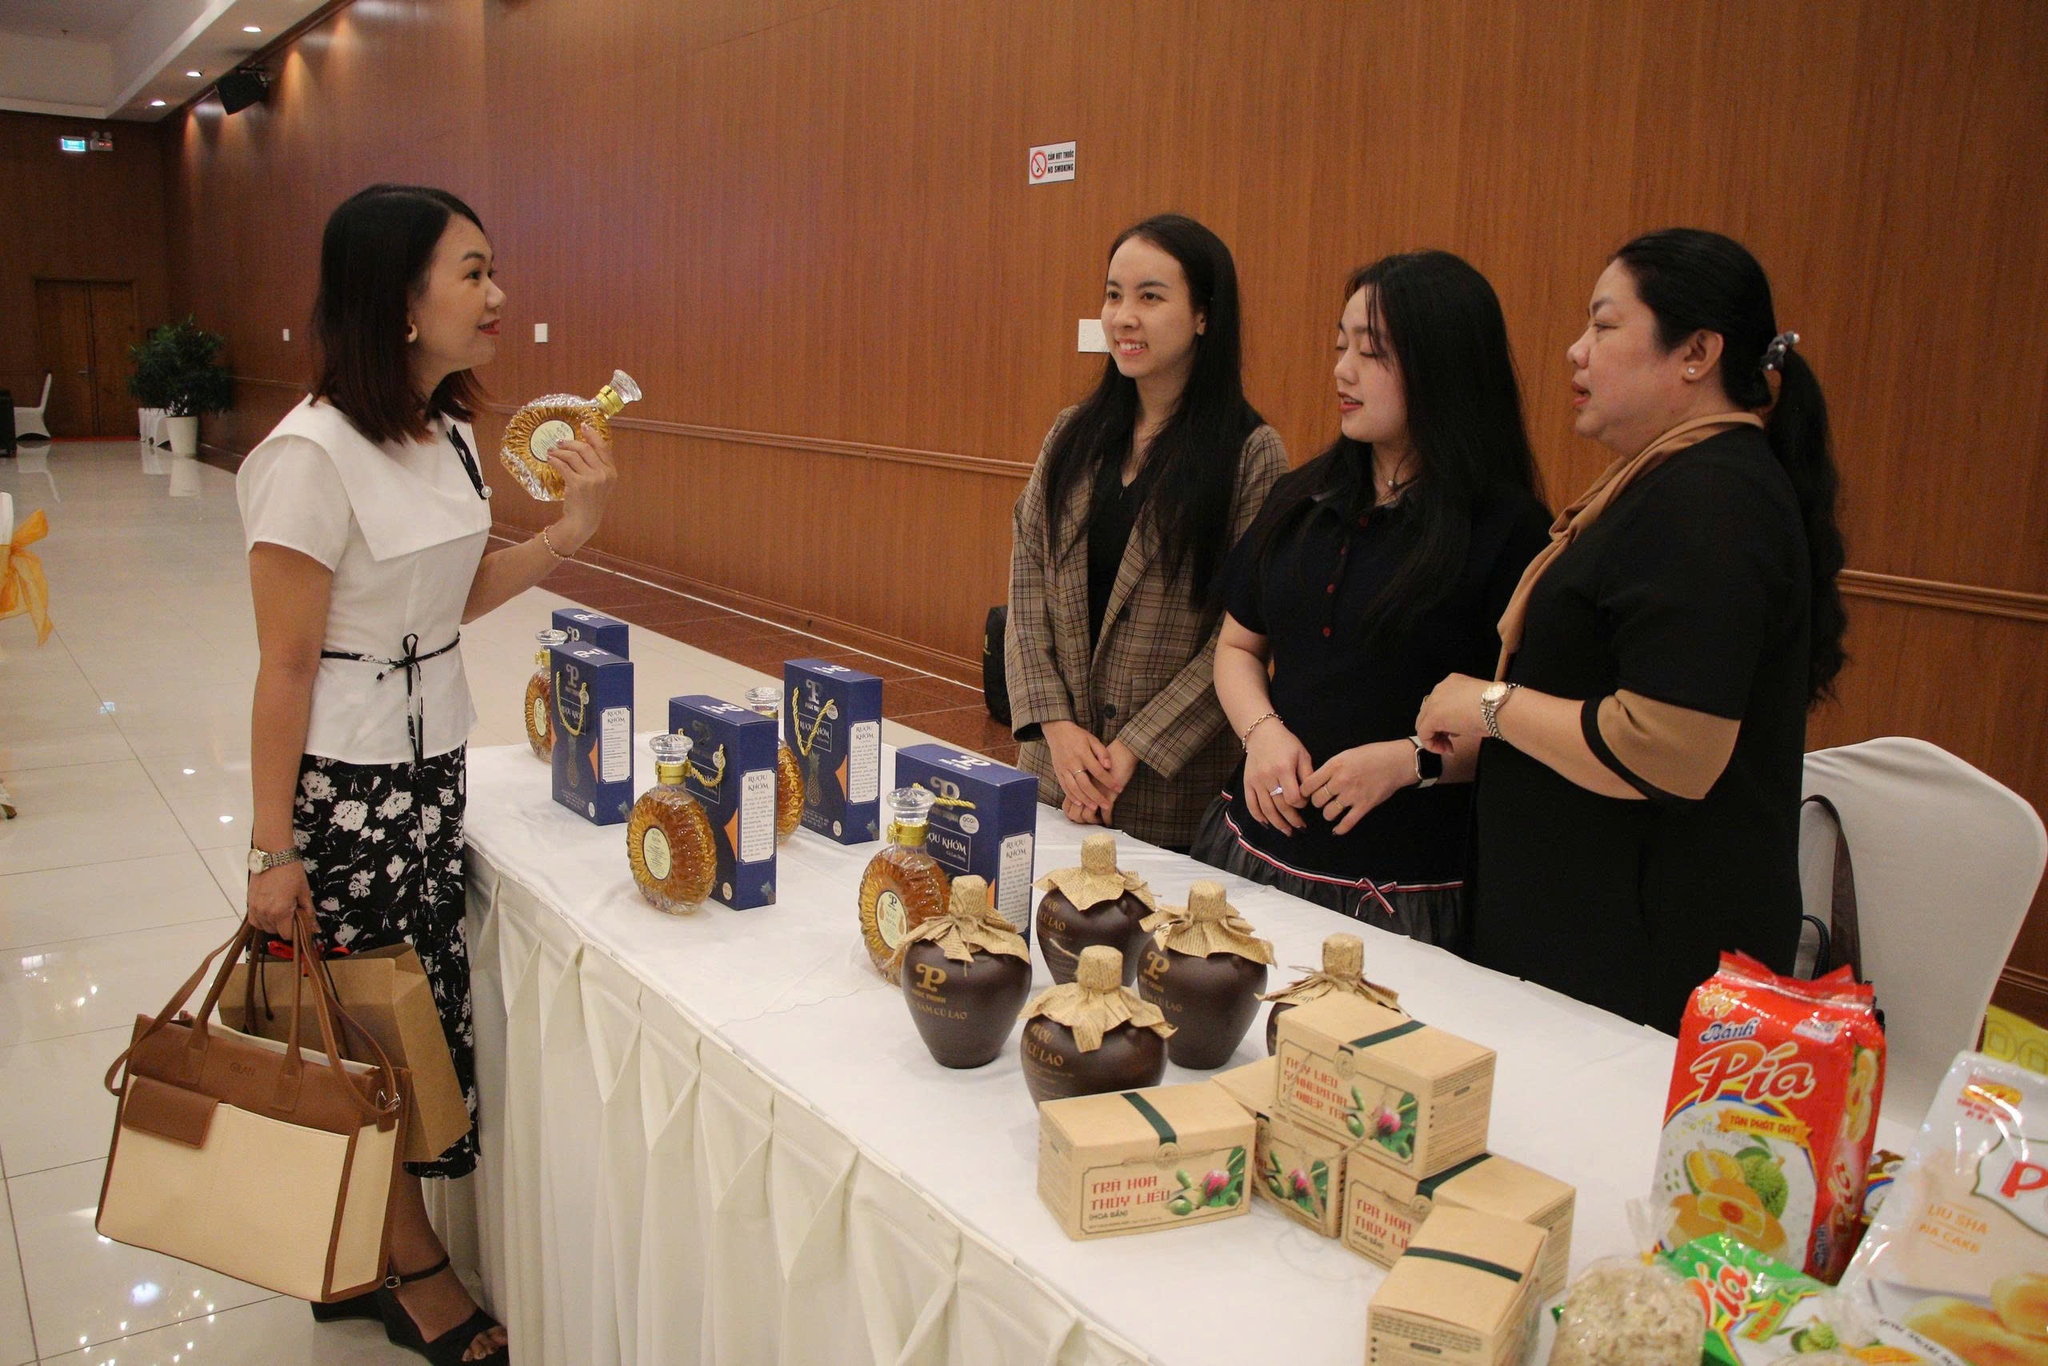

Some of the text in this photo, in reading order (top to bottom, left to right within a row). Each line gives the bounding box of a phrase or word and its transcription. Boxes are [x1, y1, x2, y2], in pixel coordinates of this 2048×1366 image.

[1048, 163, 1074, 174] NO SMOKING
[1699, 1017, 1761, 1043] Bánh
[1690, 1040, 1816, 1105] Pía
[1127, 1175, 1158, 1190] HOA
[1384, 1211, 1412, 1235] HOA
[1956, 1214, 1989, 1234] SHA
[1942, 1230, 1980, 1253] CAKE
